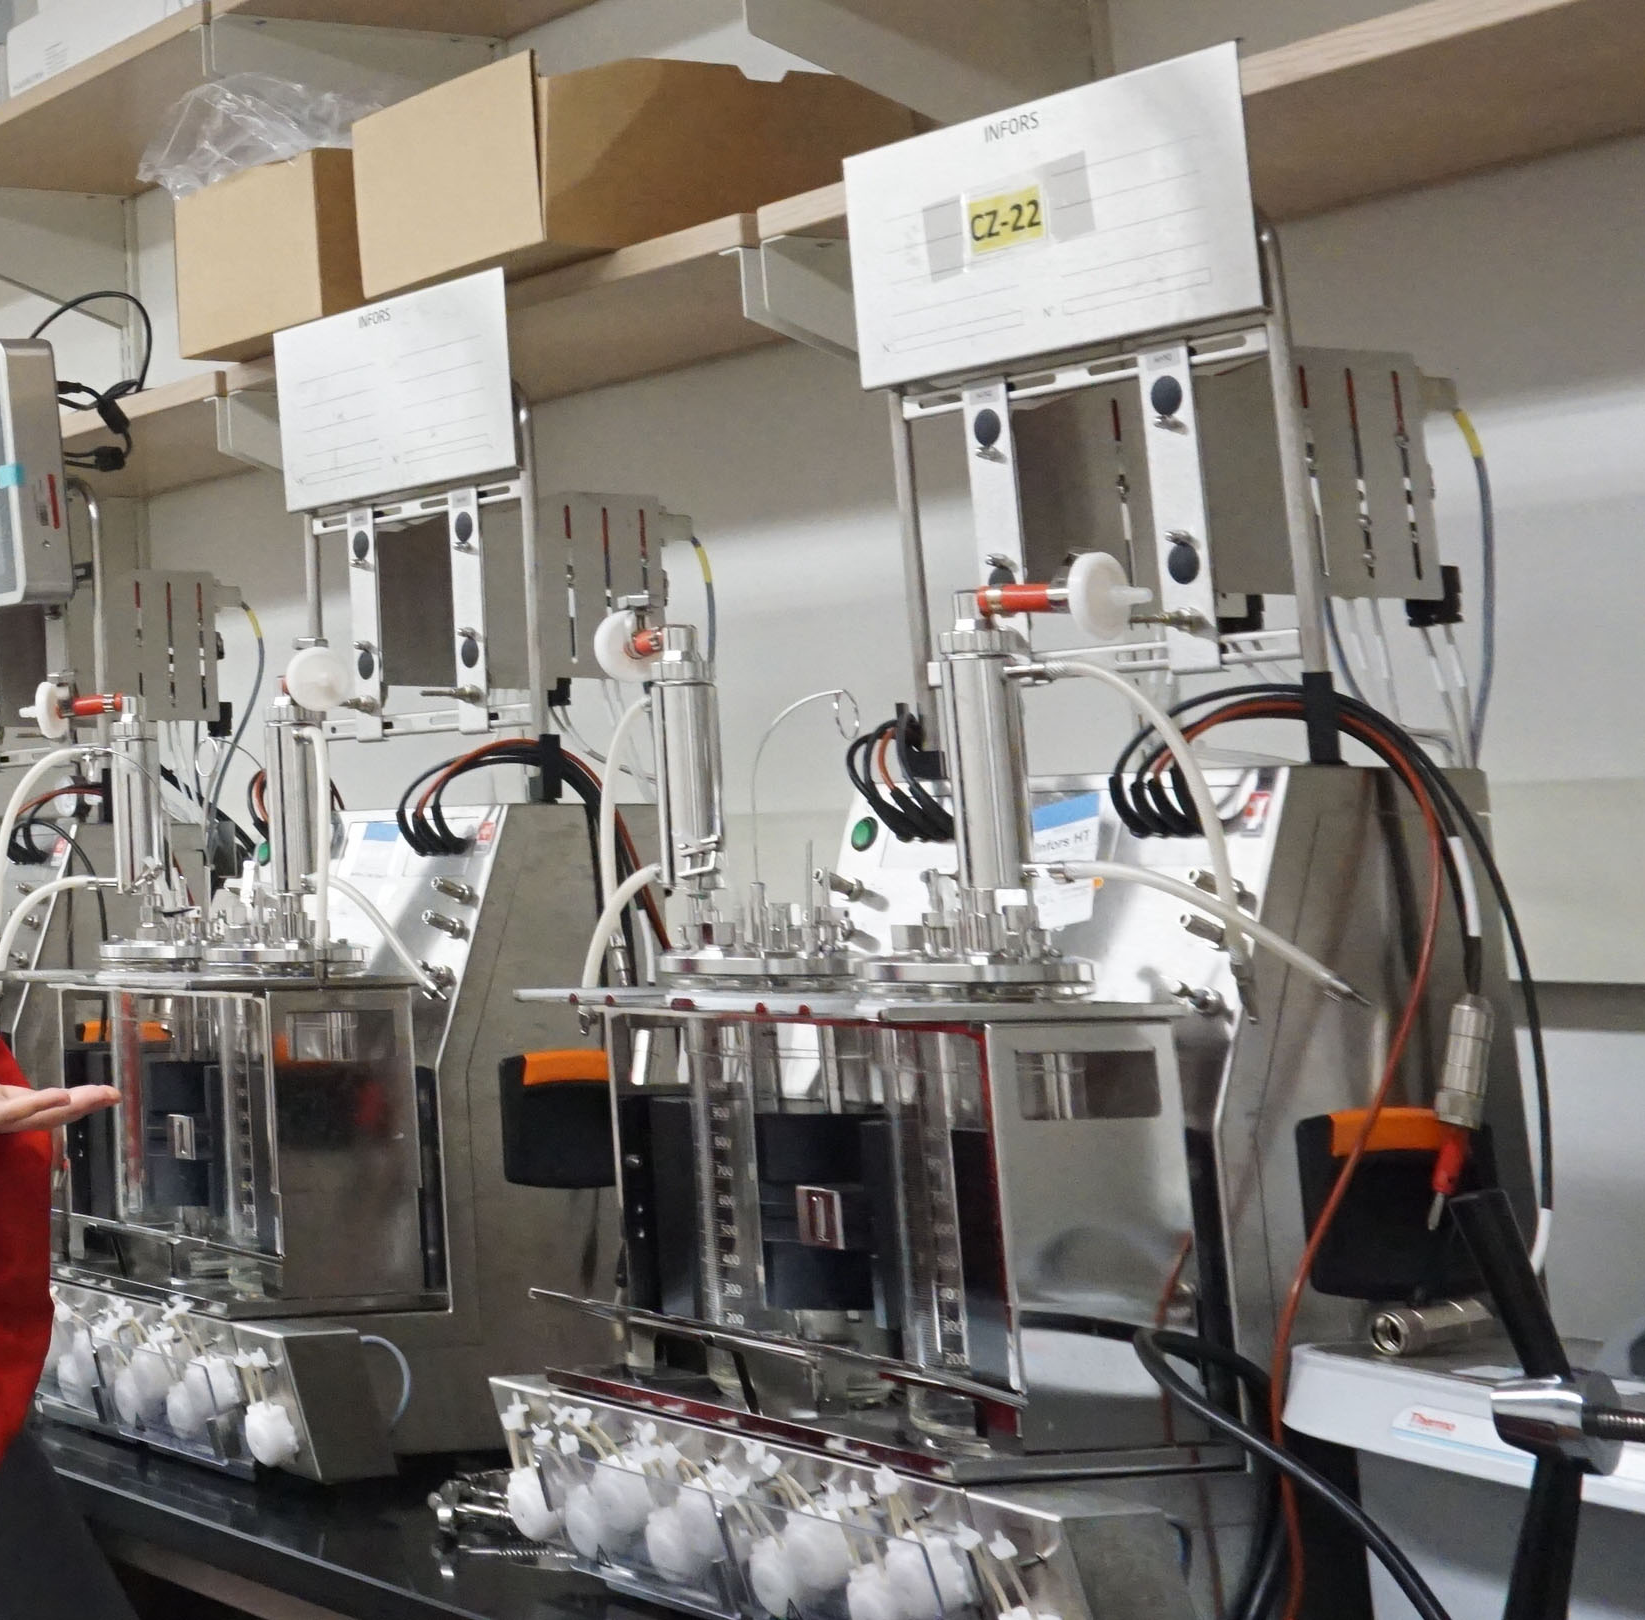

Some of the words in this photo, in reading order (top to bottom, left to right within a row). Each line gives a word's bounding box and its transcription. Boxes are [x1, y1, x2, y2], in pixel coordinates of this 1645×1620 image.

[983, 111, 1041, 144] INFORS
[970, 198, 1042, 242] CZ-22
[357, 307, 392, 329] INFORS
[716, 1164, 734, 1177] 700
[724, 1283, 742, 1296] 300
[726, 1312, 745, 1325] 200
